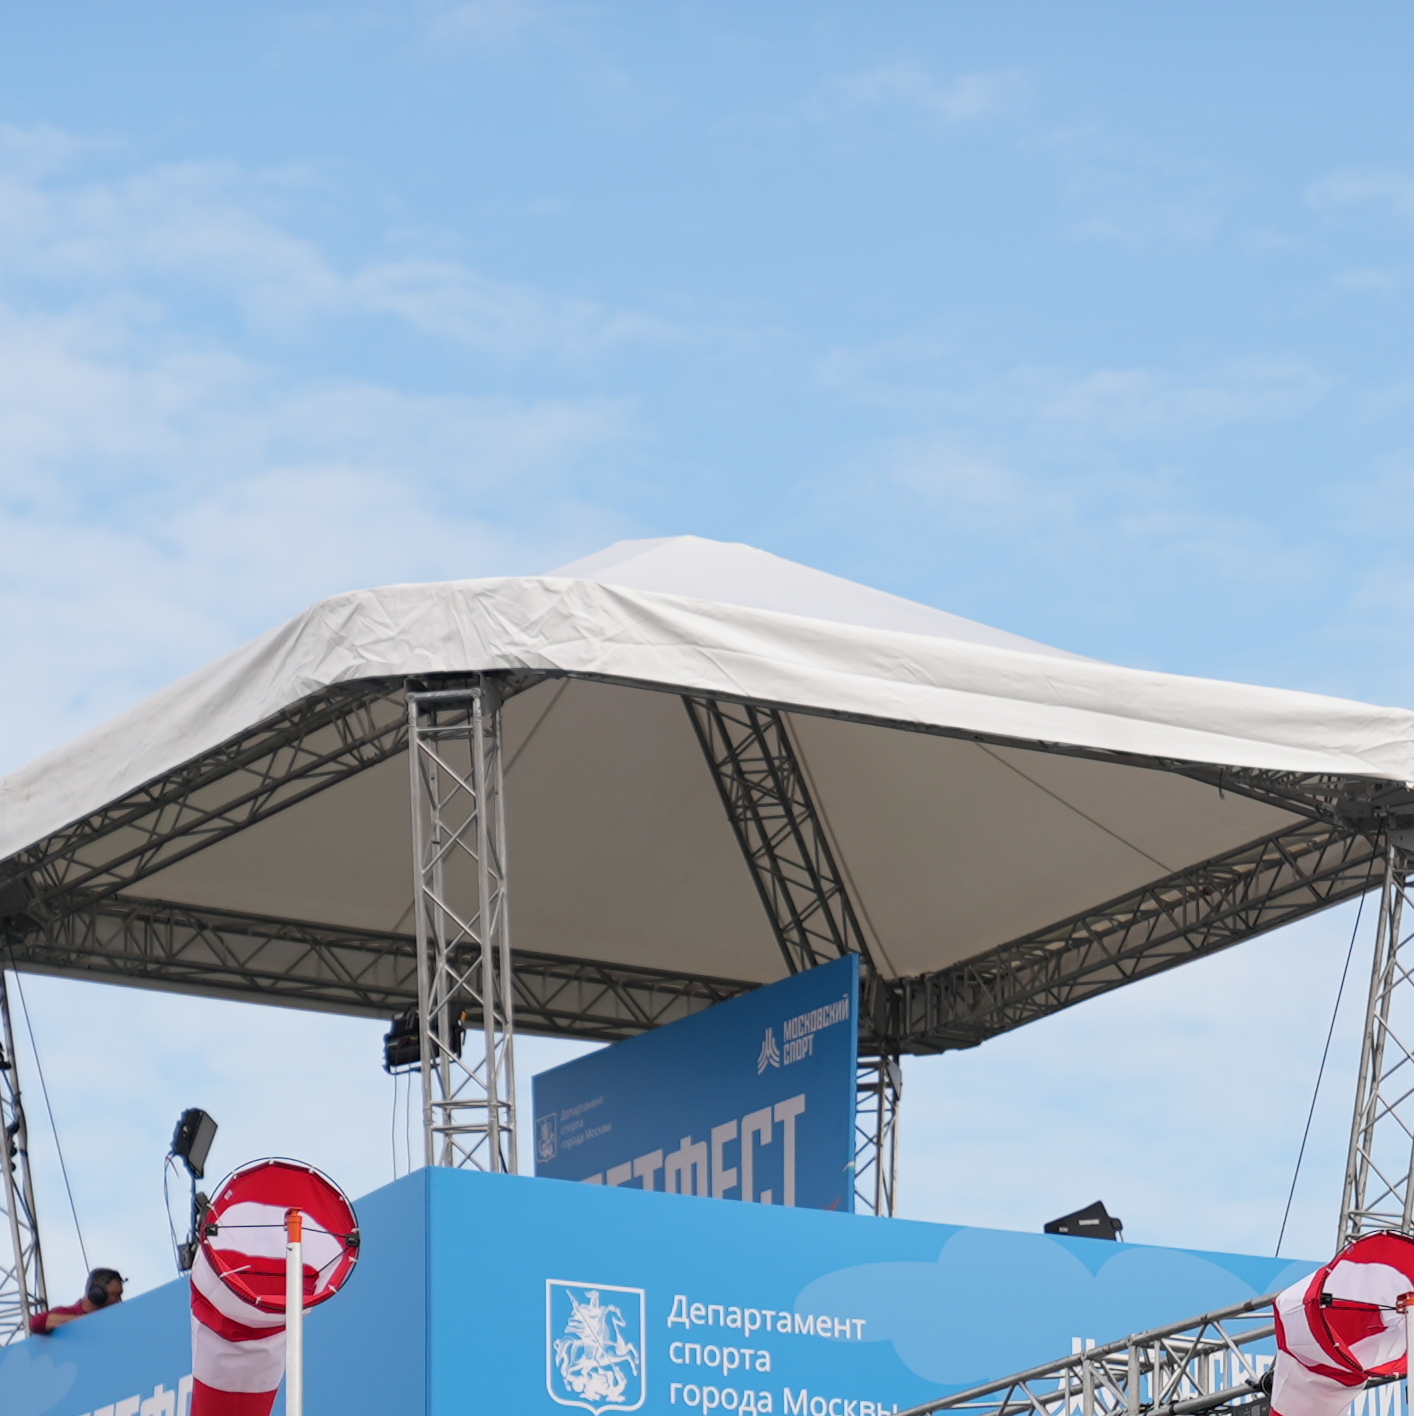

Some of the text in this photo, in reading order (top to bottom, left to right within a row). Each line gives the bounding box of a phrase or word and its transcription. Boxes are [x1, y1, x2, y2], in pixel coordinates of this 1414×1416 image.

[783, 993, 849, 1039] МОСКОВСКИЙ
[783, 1034, 814, 1066] СПОРТ
[667, 1294, 866, 1341] Департамент
[669, 1341, 771, 1376] спорта
